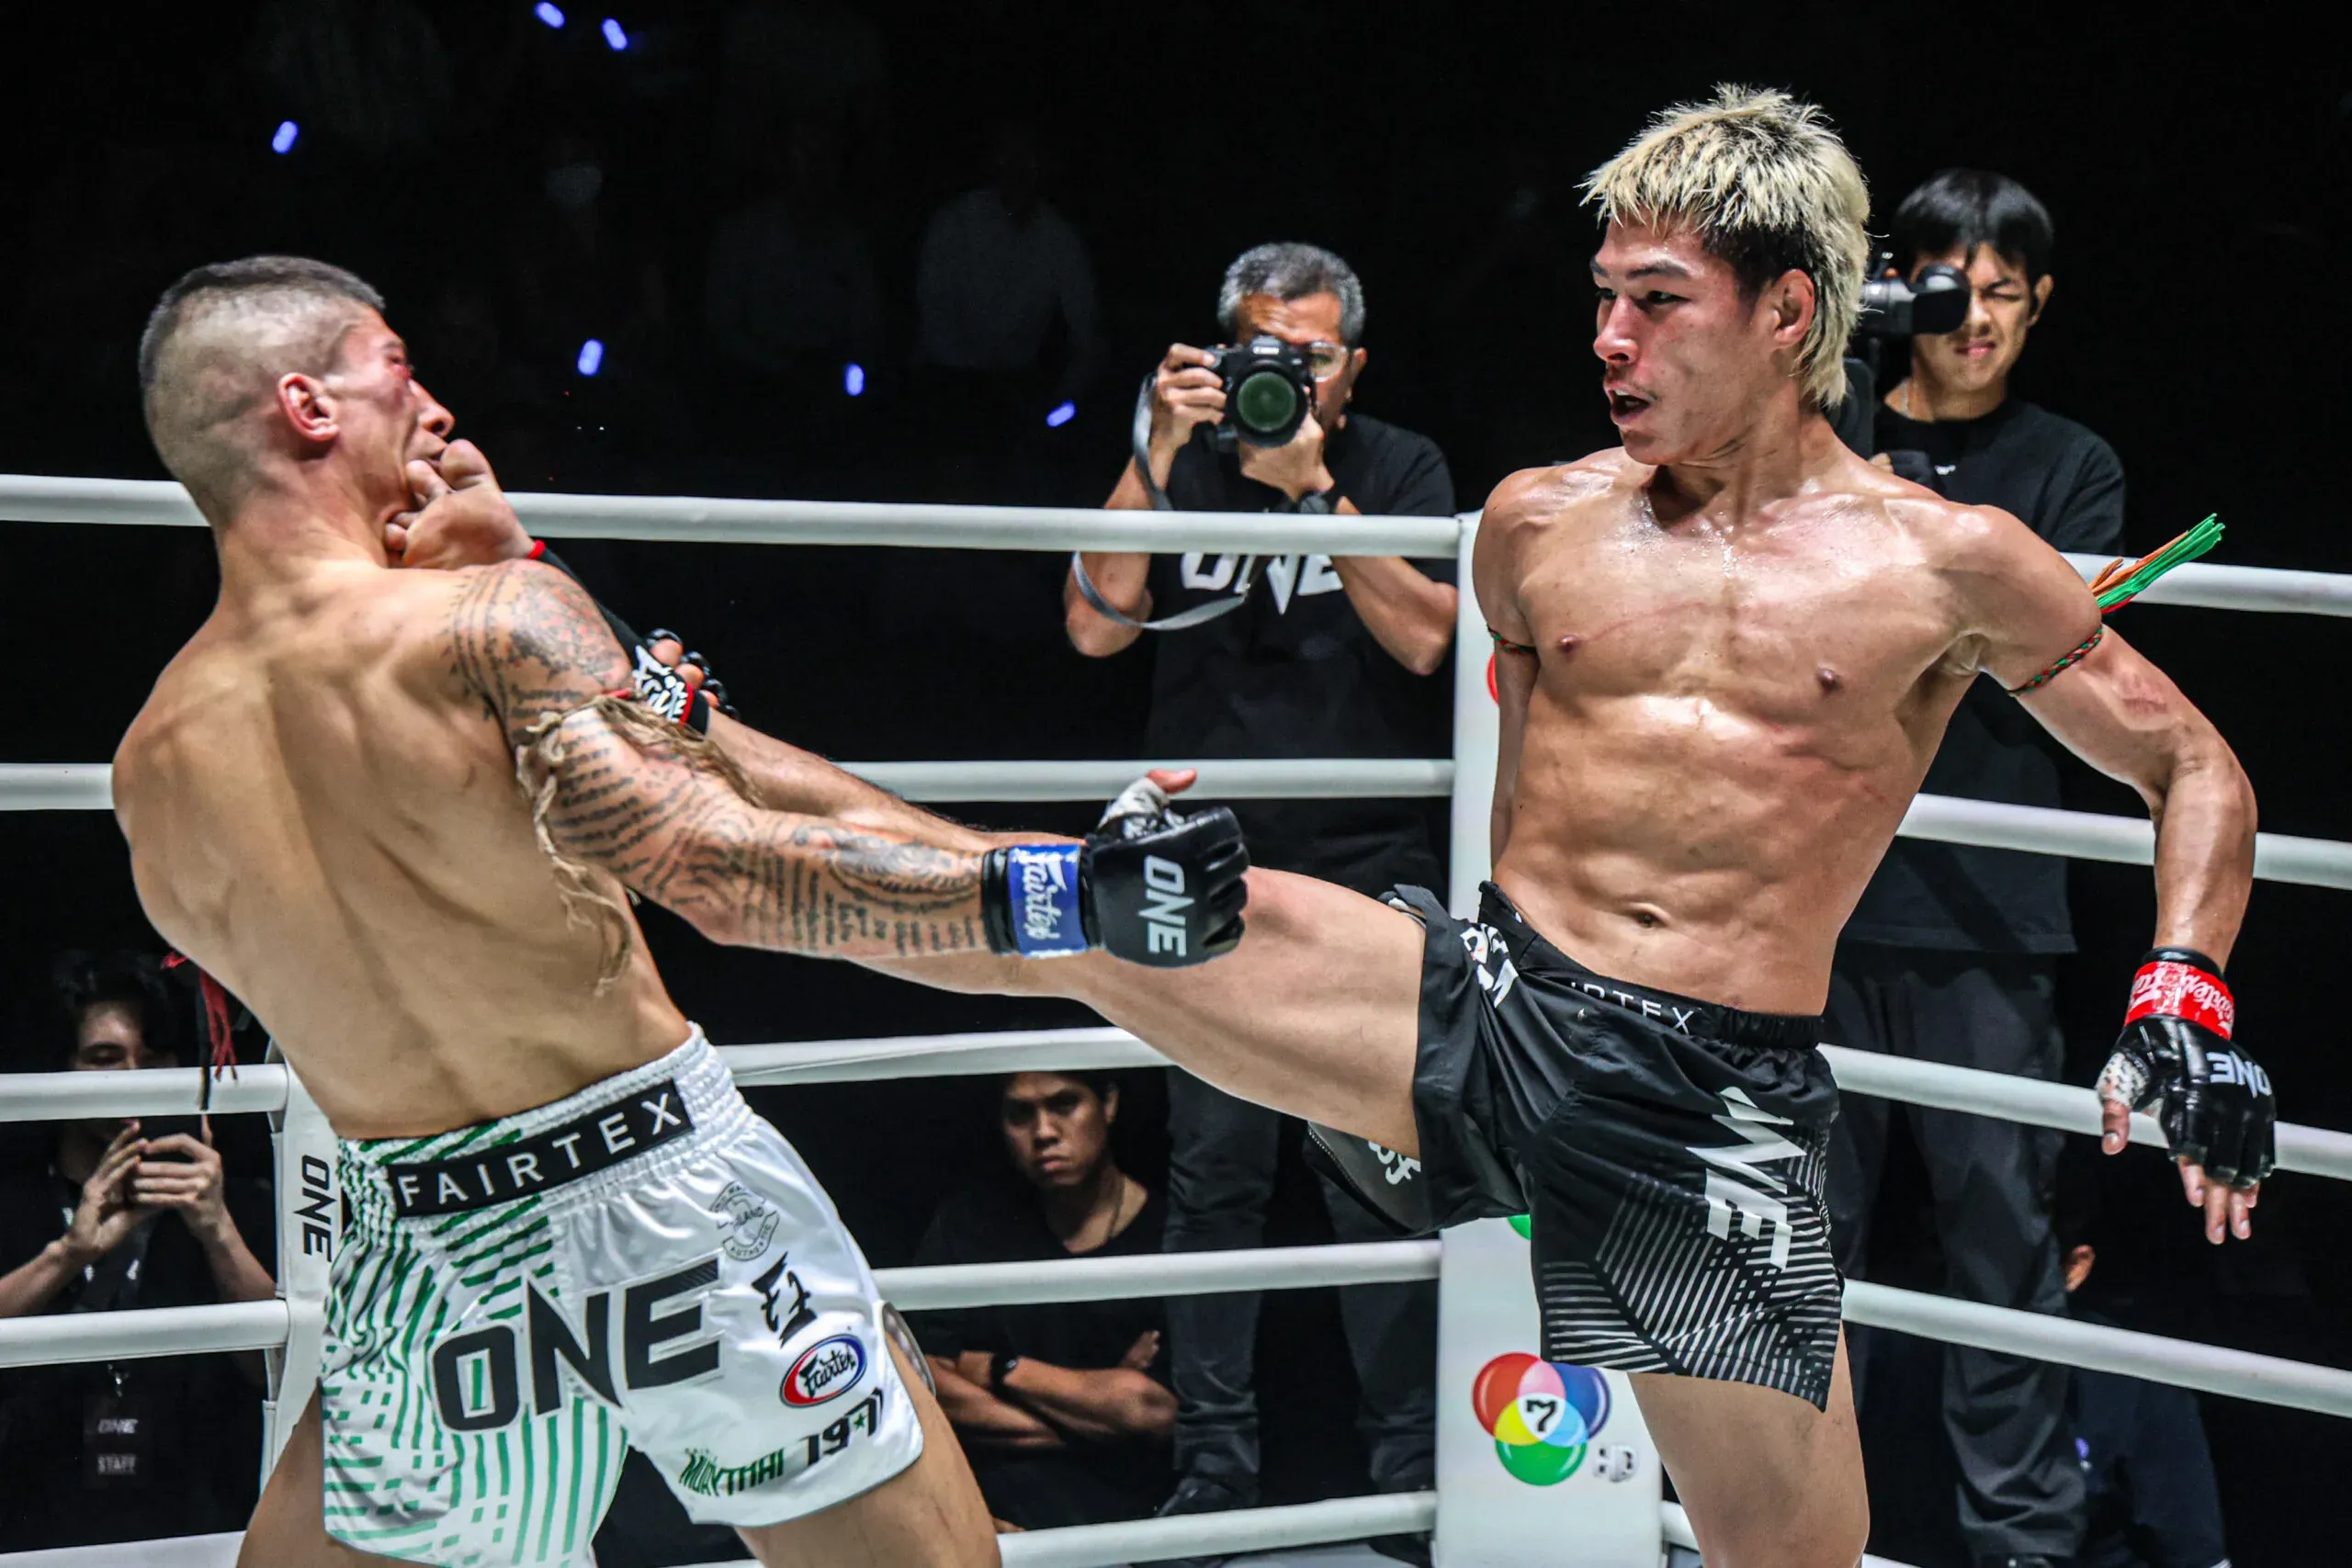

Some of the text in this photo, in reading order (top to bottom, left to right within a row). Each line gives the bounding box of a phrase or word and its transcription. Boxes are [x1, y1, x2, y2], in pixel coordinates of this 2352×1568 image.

[1137, 854, 1195, 957] ONE
[2206, 1051, 2273, 1099] ONE
[397, 1092, 683, 1207] FAIRTEX
[293, 1154, 338, 1263] ONE
[431, 1255, 721, 1433] ONE
[798, 1342, 857, 1399] Fairtex
[1525, 1399, 1558, 1433] 7
